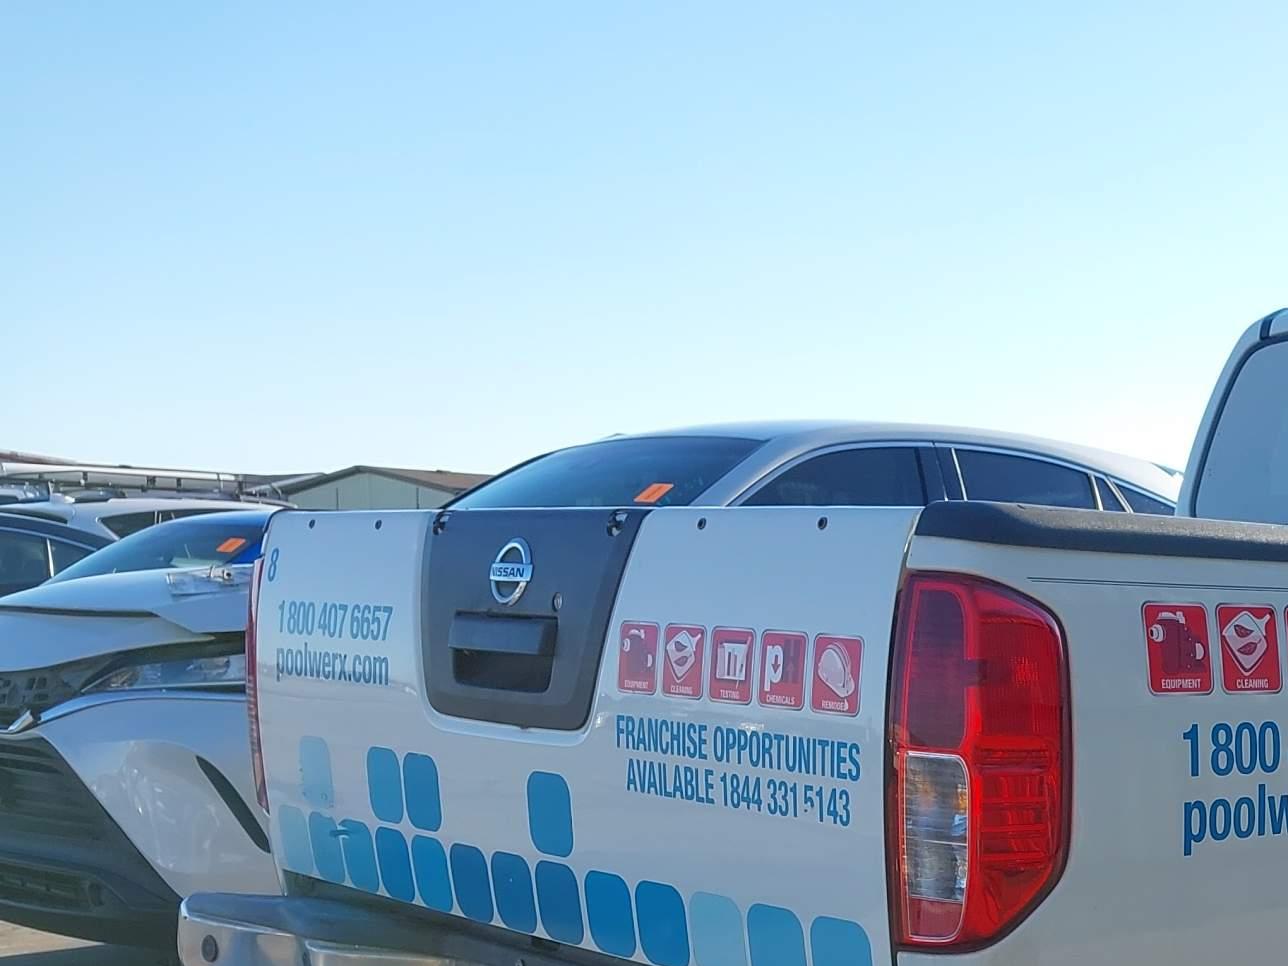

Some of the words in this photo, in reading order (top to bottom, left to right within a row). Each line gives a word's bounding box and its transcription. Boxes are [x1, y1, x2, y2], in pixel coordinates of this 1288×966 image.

[267, 548, 280, 582] 8
[492, 565, 525, 578] NISSAN
[317, 602, 348, 639] 407
[350, 604, 393, 641] 6657
[276, 642, 389, 686] poolwerx.com
[720, 689, 740, 699] TESTING
[766, 694, 796, 705] CHEMICALS
[1161, 678, 1202, 689] EQUIPMENT
[1236, 678, 1269, 689] CLEANING
[616, 714, 708, 761] FRANCHISE
[713, 725, 861, 782] OPPORTUNITIES
[1182, 723, 1199, 777] 1
[1210, 720, 1281, 777] 800
[626, 758, 715, 805] AVAILABLE
[720, 771, 762, 813] 1844
[767, 778, 798, 818] 331
[803, 784, 851, 827] 5143
